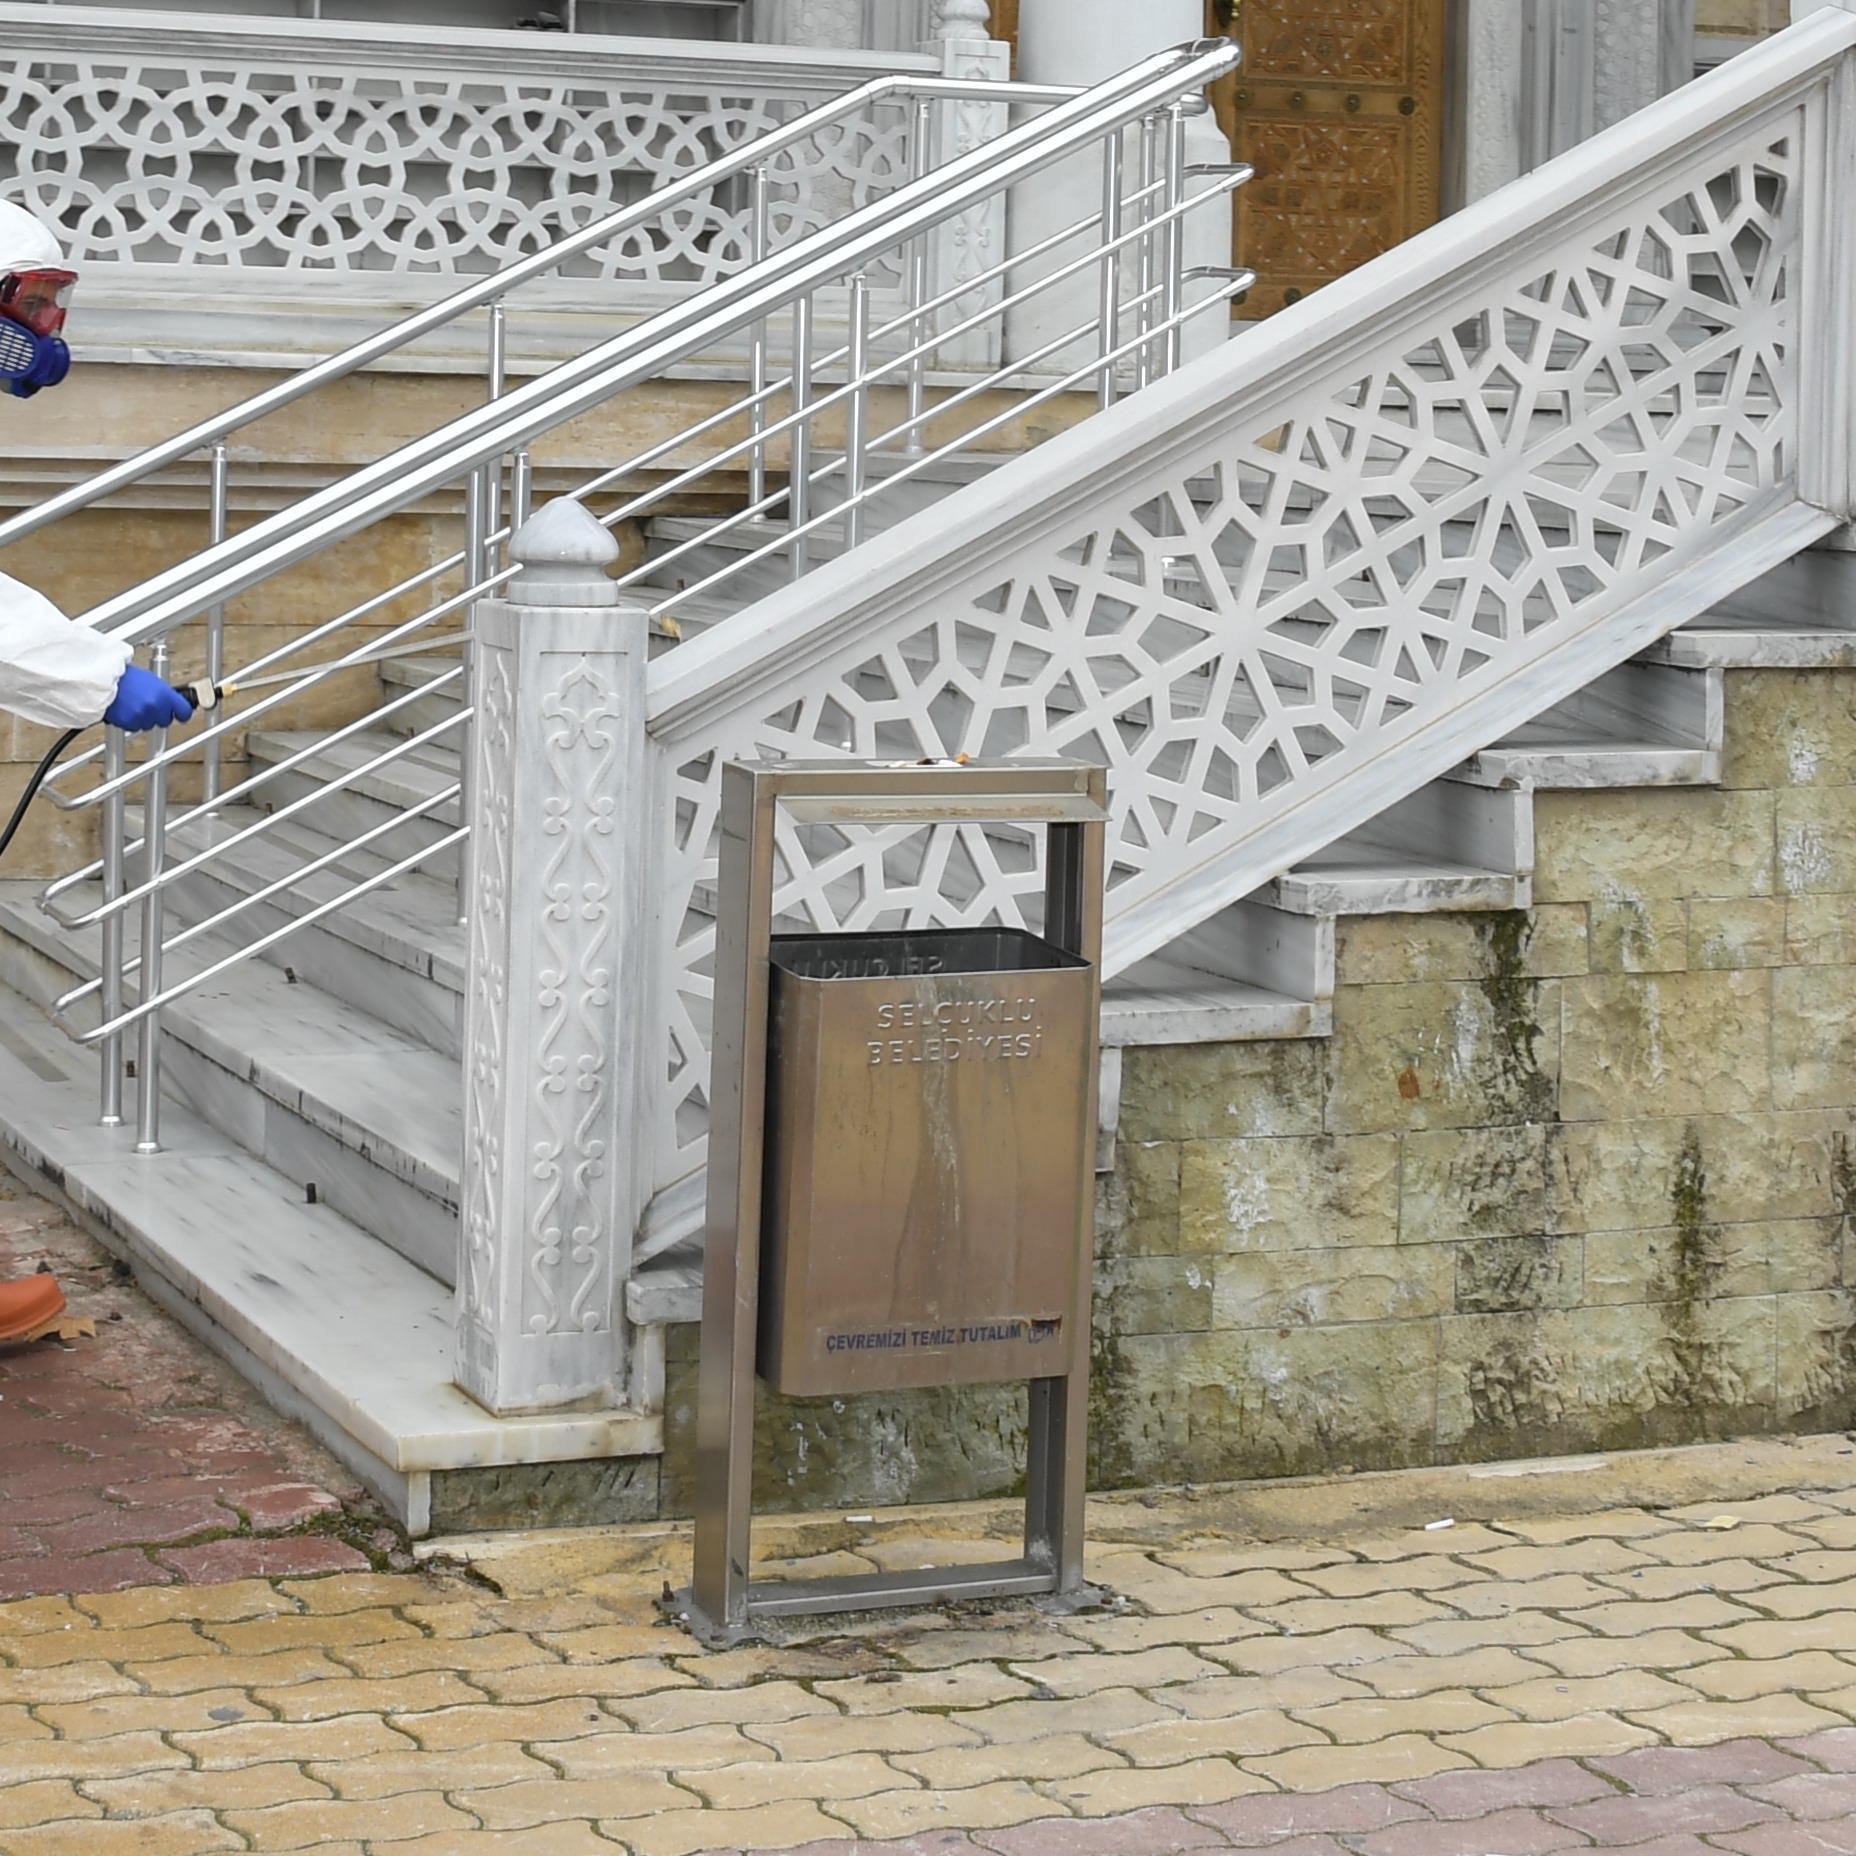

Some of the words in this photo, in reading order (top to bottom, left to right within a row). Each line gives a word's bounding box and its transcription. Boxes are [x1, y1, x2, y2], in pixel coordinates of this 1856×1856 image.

[867, 1025, 1042, 1064] BELEDİYESİ
[826, 1328, 907, 1354] ÇEVREMİZİ
[911, 1325, 955, 1347] TEMİZ
